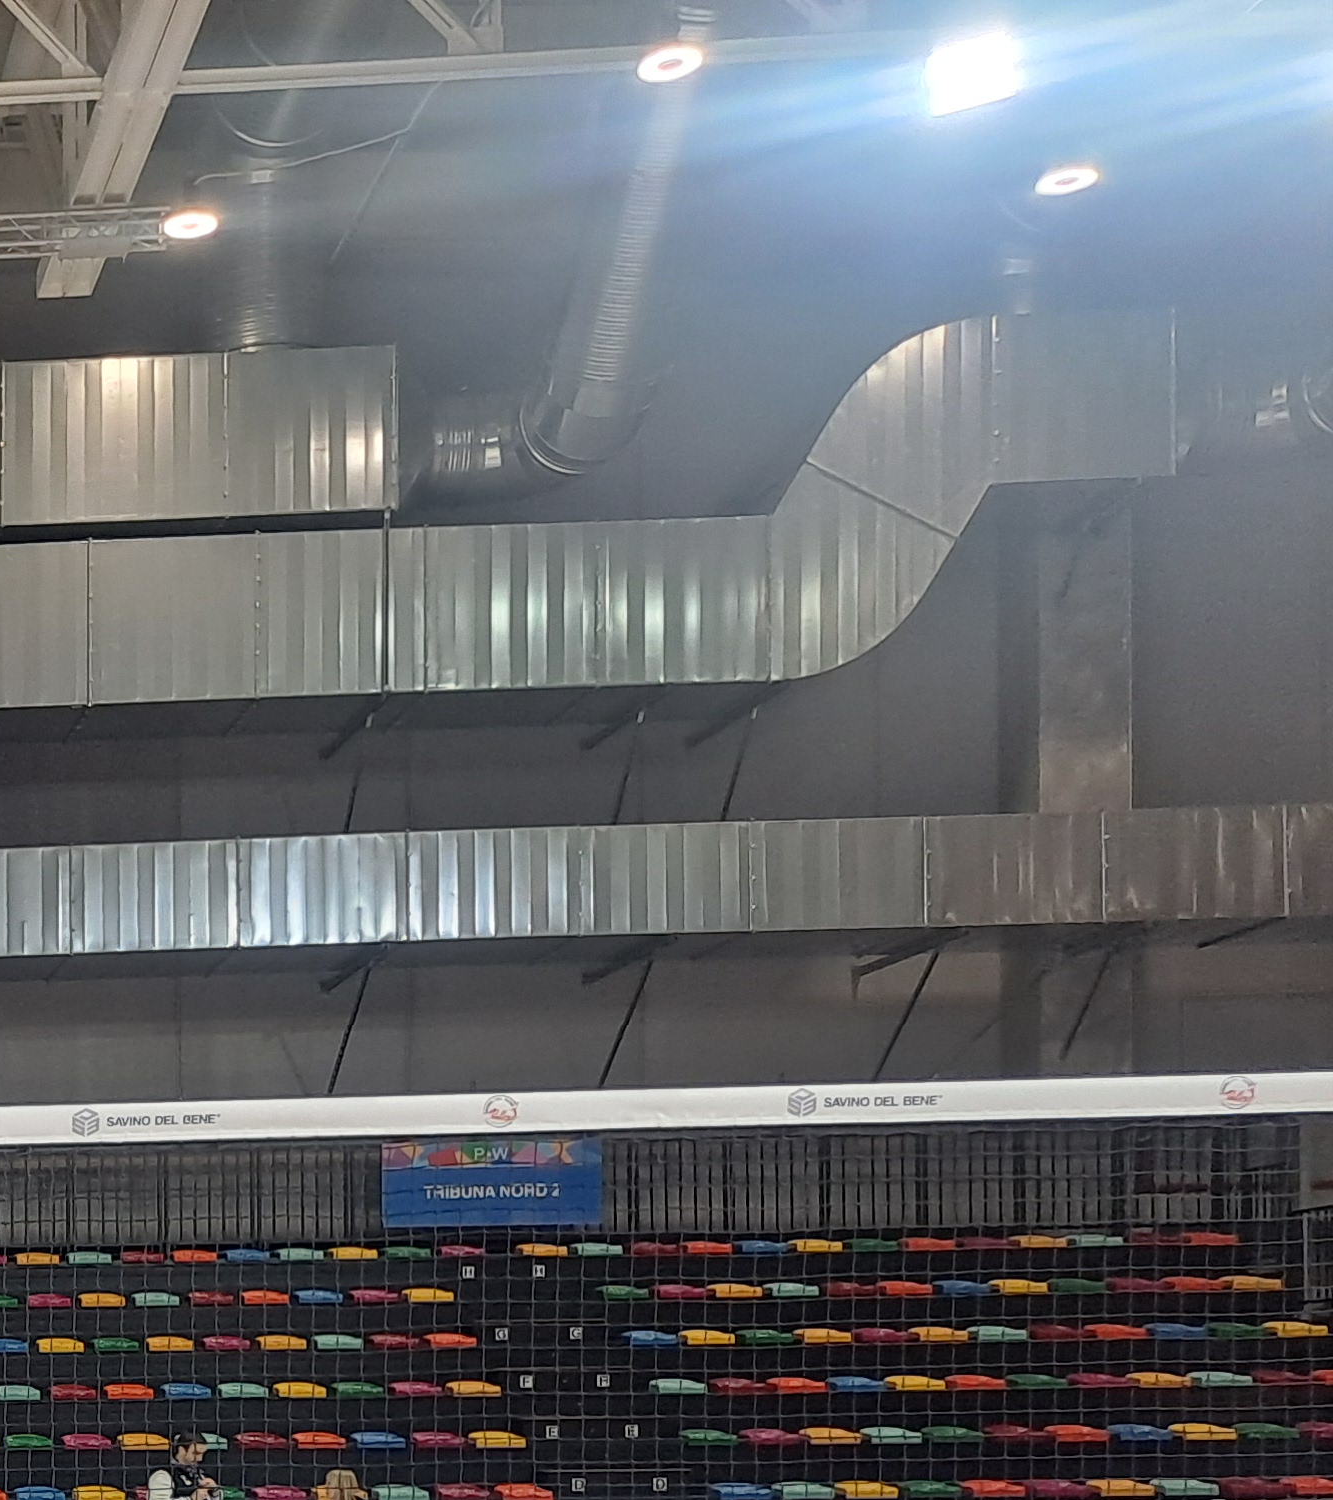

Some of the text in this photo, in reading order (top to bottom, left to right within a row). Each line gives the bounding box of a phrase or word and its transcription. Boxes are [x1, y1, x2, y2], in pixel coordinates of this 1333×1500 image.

[874, 1096, 899, 1107] DEL
[155, 1114, 178, 1125] DEL
[423, 1185, 495, 1200] TRIBUNA
[499, 1183, 548, 1198] NORD
